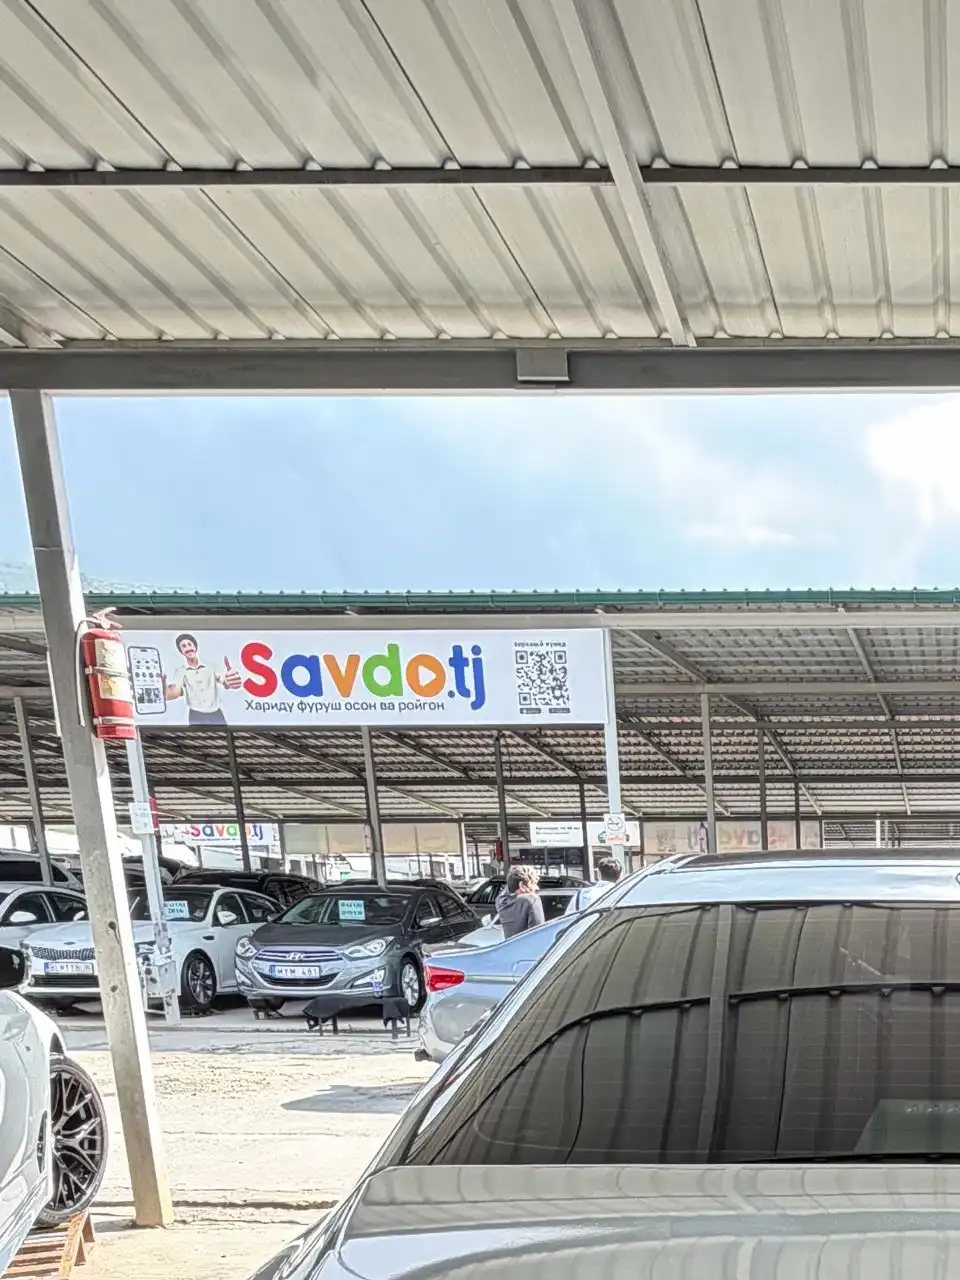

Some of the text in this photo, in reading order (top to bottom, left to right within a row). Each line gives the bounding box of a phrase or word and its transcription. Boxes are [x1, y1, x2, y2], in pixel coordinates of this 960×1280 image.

[241, 642, 486, 711] Savdo.tj
[245, 699, 294, 713] Хариду
[345, 701, 377, 711] осон
[380, 701, 395, 711] ва
[399, 699, 445, 713] ройгон
